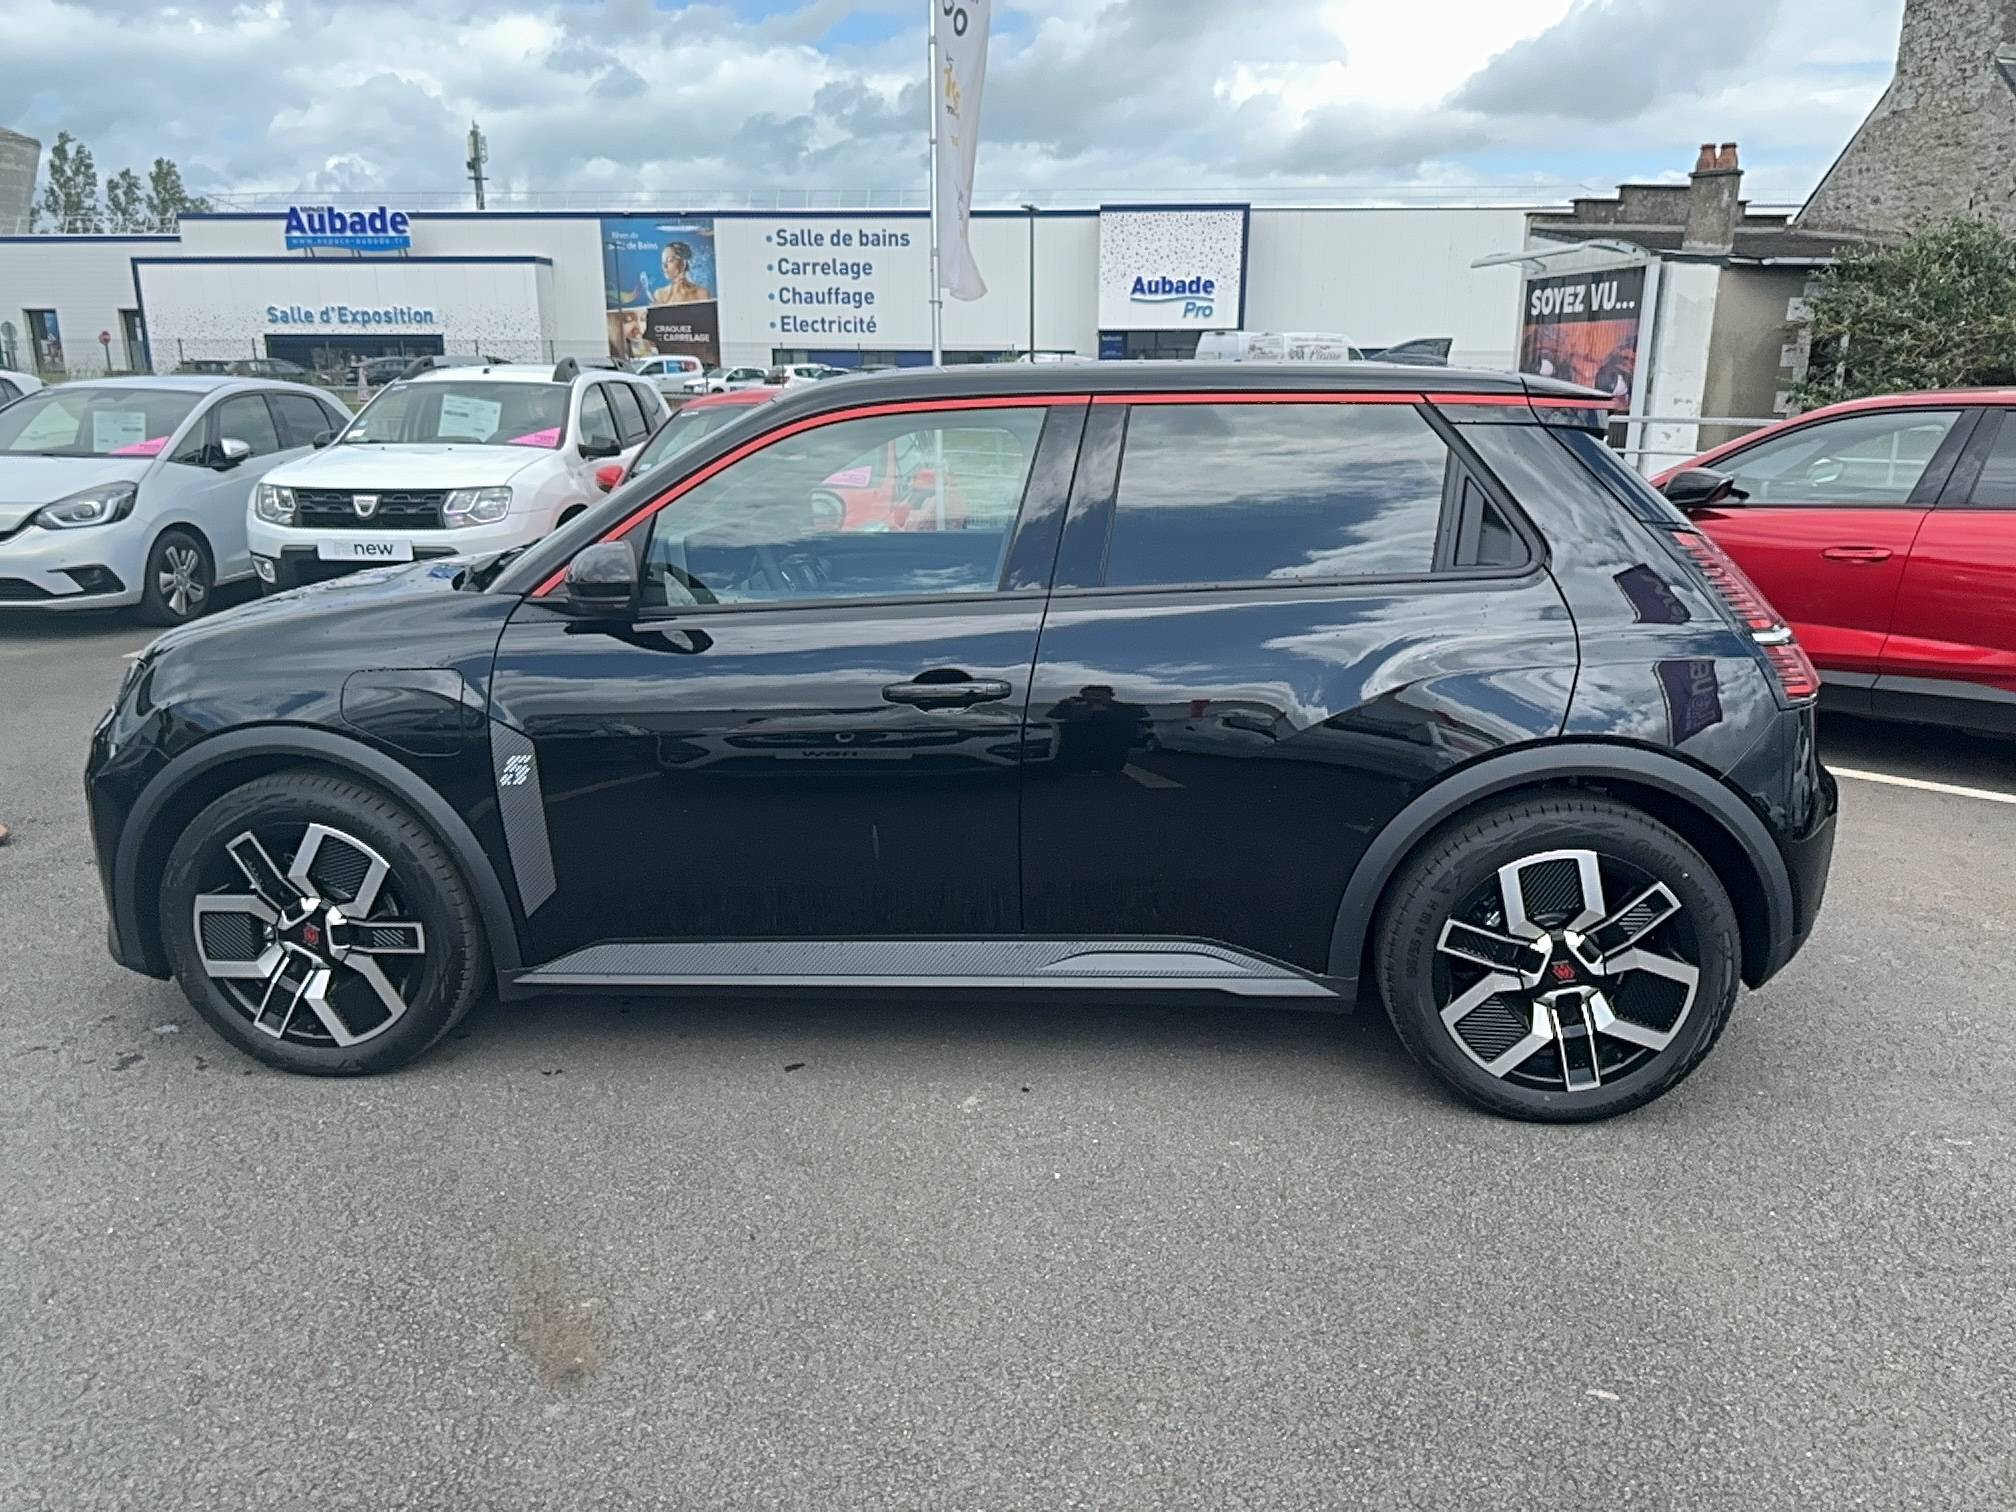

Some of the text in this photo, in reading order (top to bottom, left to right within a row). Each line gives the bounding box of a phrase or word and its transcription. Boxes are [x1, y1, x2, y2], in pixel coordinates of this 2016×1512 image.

[285, 206, 409, 234] Aubade
[776, 229, 910, 247] Salle de bains
[777, 258, 873, 278] Carrelage
[1131, 276, 1215, 295] Aubade
[779, 287, 875, 307] Chauffage
[1531, 281, 1635, 316] SOYEZ VU...
[267, 306, 434, 327] Salle d'Exposition
[1183, 302, 1214, 319] Pro
[780, 315, 877, 334] Electricité
